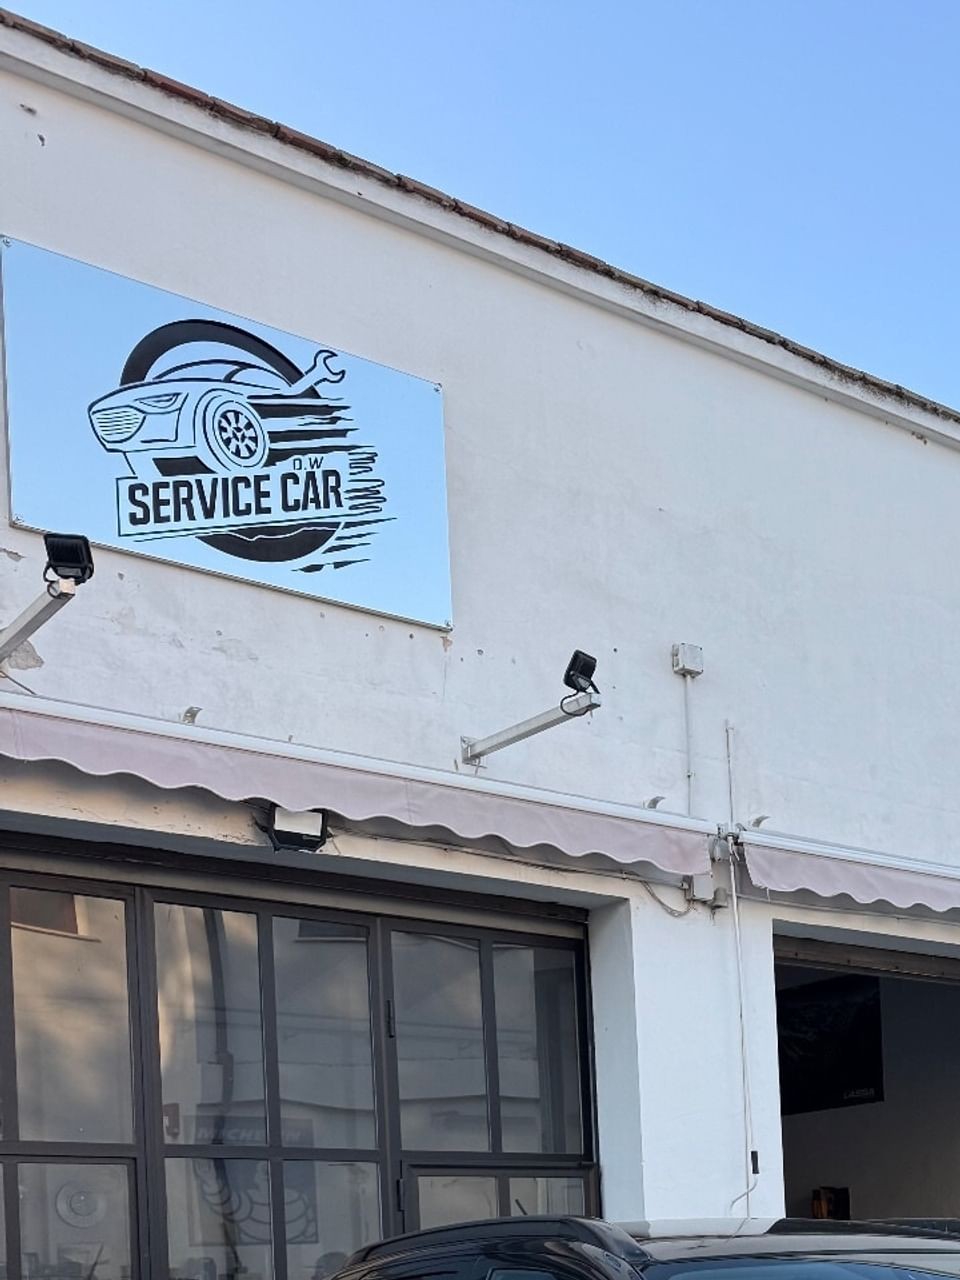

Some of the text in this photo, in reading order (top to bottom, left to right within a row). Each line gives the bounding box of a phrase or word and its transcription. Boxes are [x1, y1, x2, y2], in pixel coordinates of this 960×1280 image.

[128, 470, 344, 526] SERVICE CAR
[197, 1127, 302, 1142] MICHEIN
